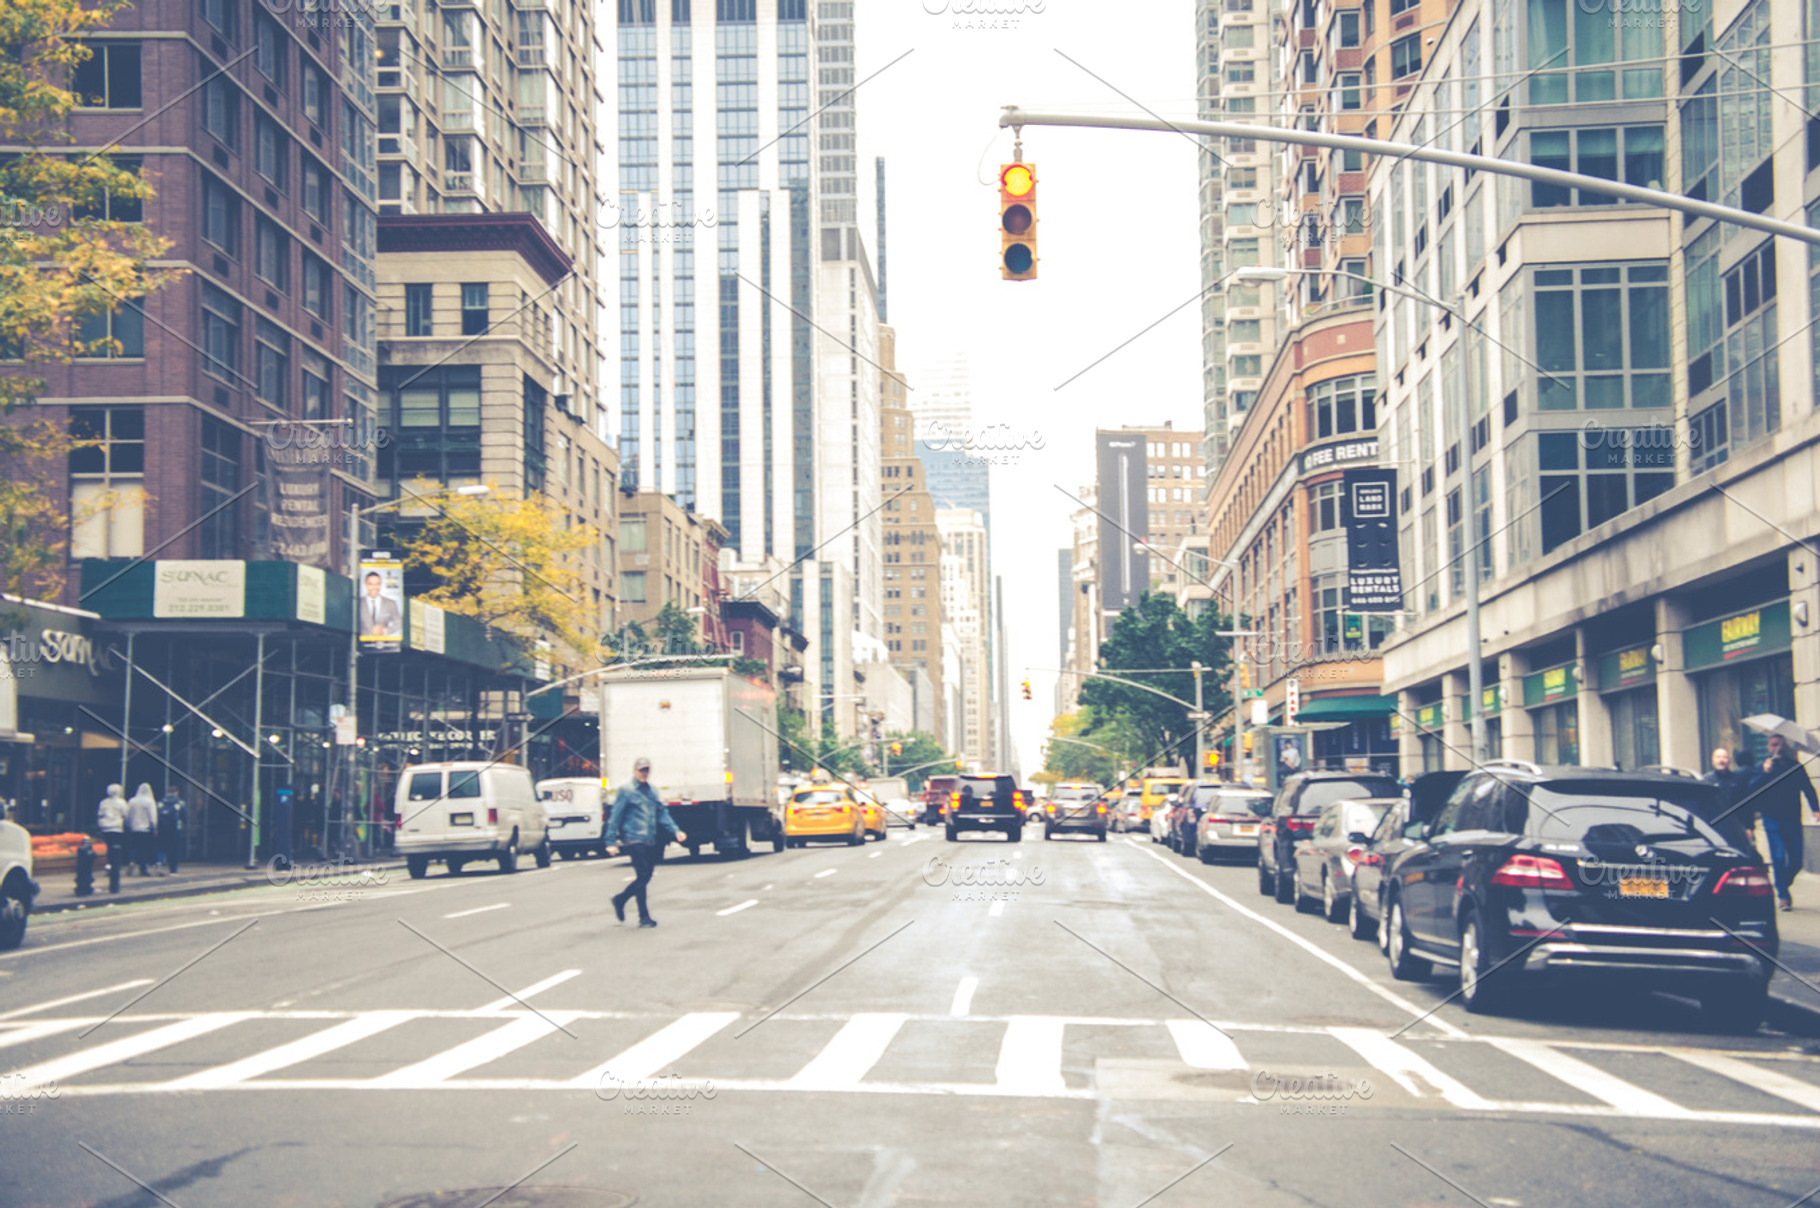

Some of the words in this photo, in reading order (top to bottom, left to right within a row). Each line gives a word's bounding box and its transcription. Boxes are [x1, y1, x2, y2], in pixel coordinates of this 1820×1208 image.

[1312, 449, 1334, 467] FEE
[1350, 576, 1399, 585] LUXURY
[1350, 584, 1400, 594] RENTALS
